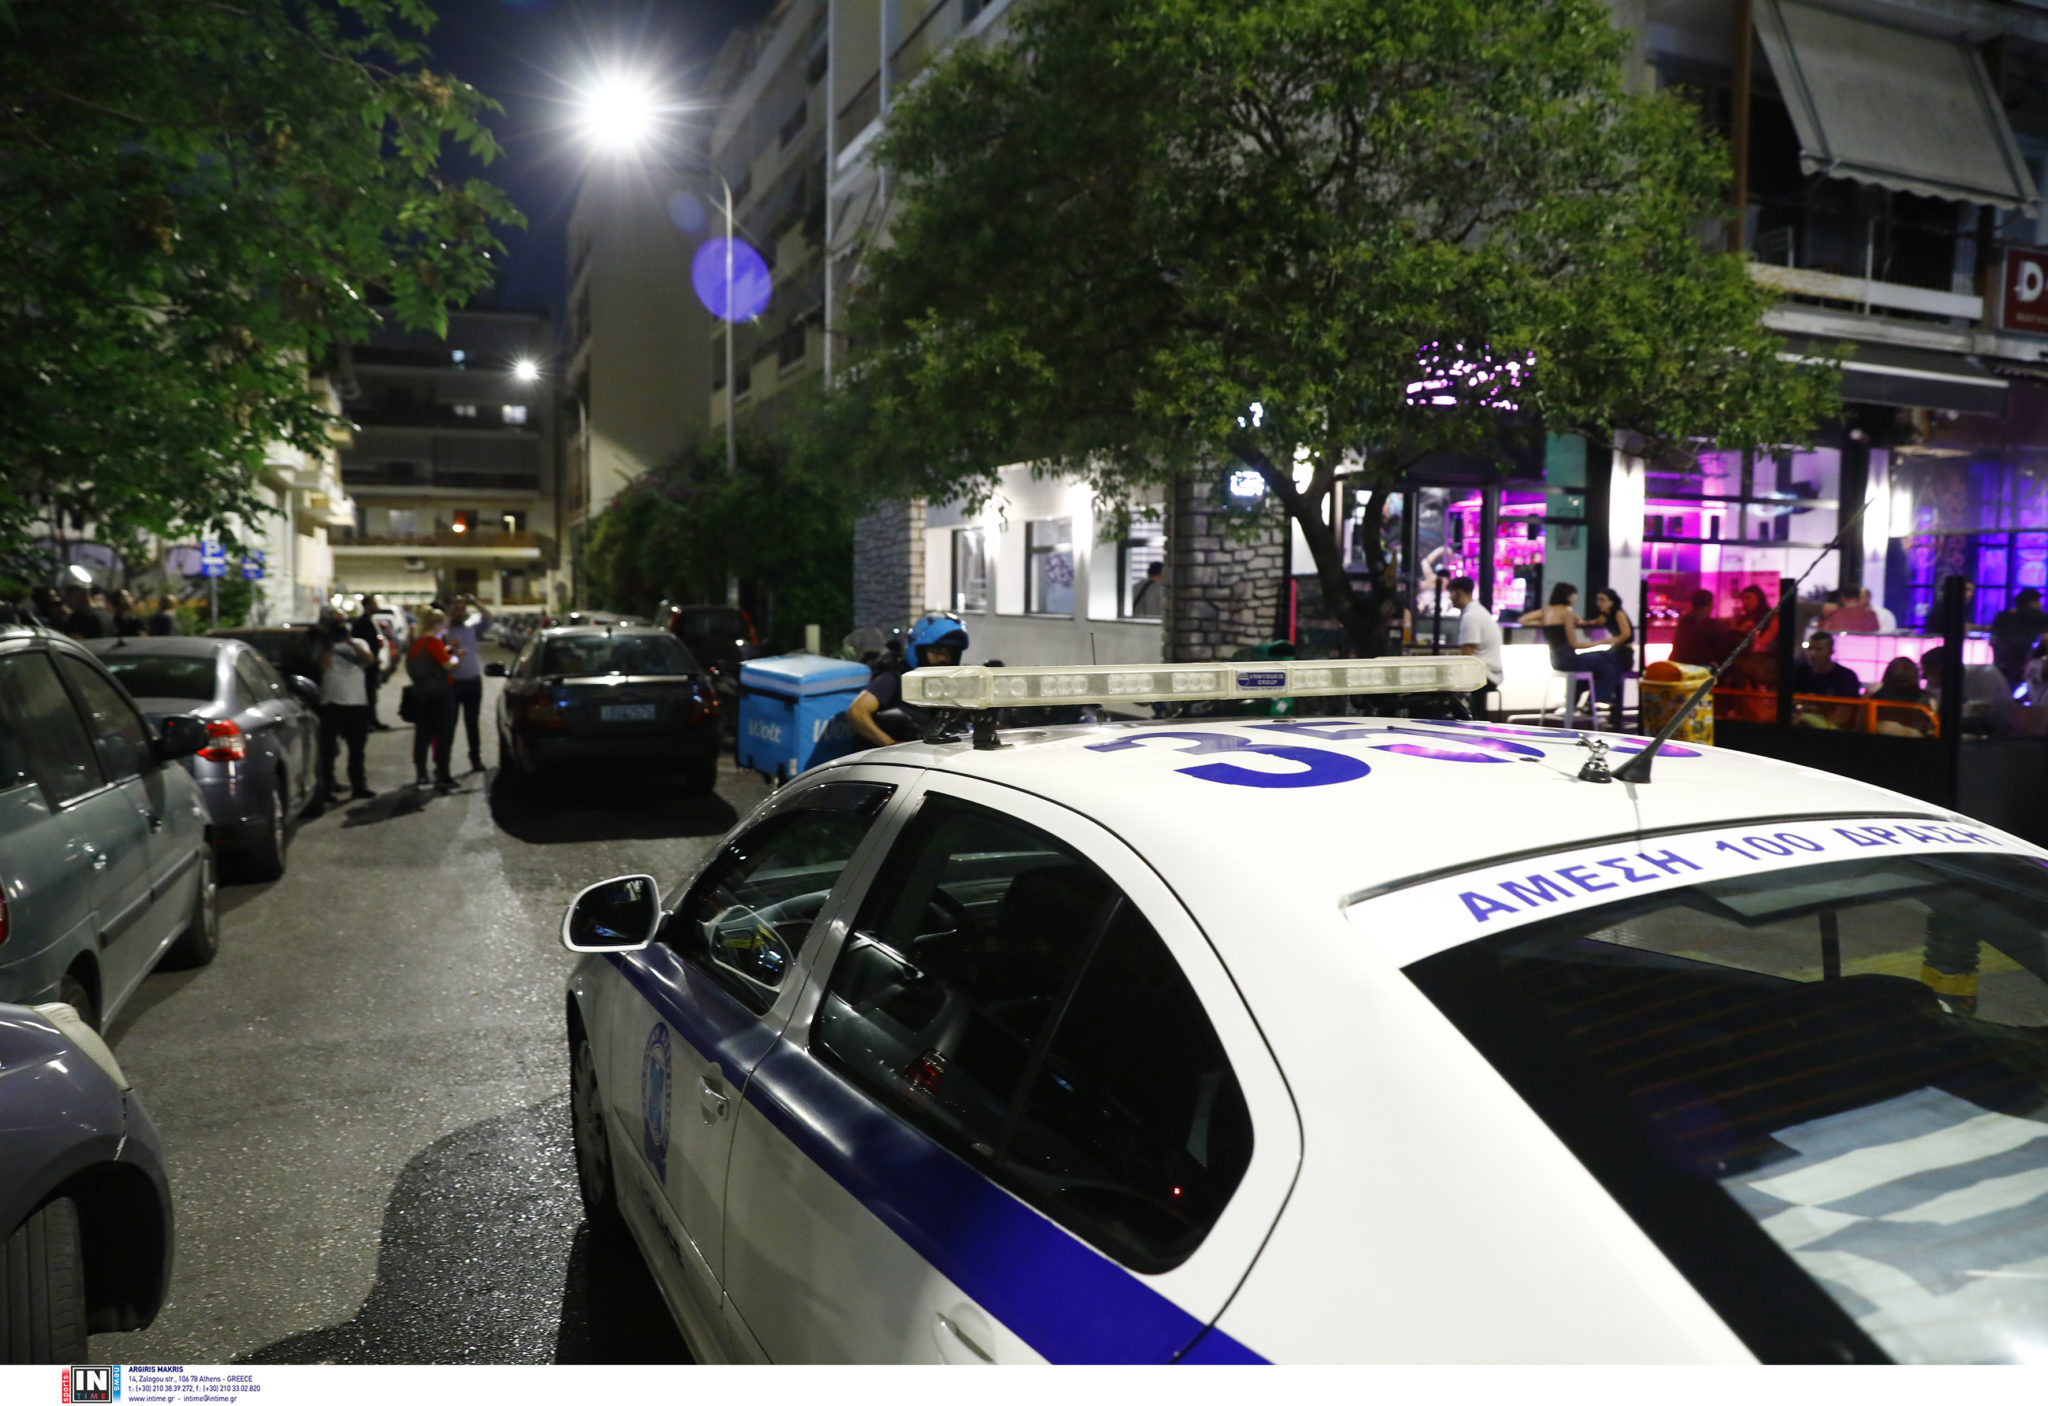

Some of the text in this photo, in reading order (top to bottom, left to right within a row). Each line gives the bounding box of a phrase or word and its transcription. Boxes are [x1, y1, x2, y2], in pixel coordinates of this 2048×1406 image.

[2018, 260, 2047, 303] D
[1457, 826, 2002, 922] ΑΜΕΣΗ 100 ΔΡΑΣΗ
